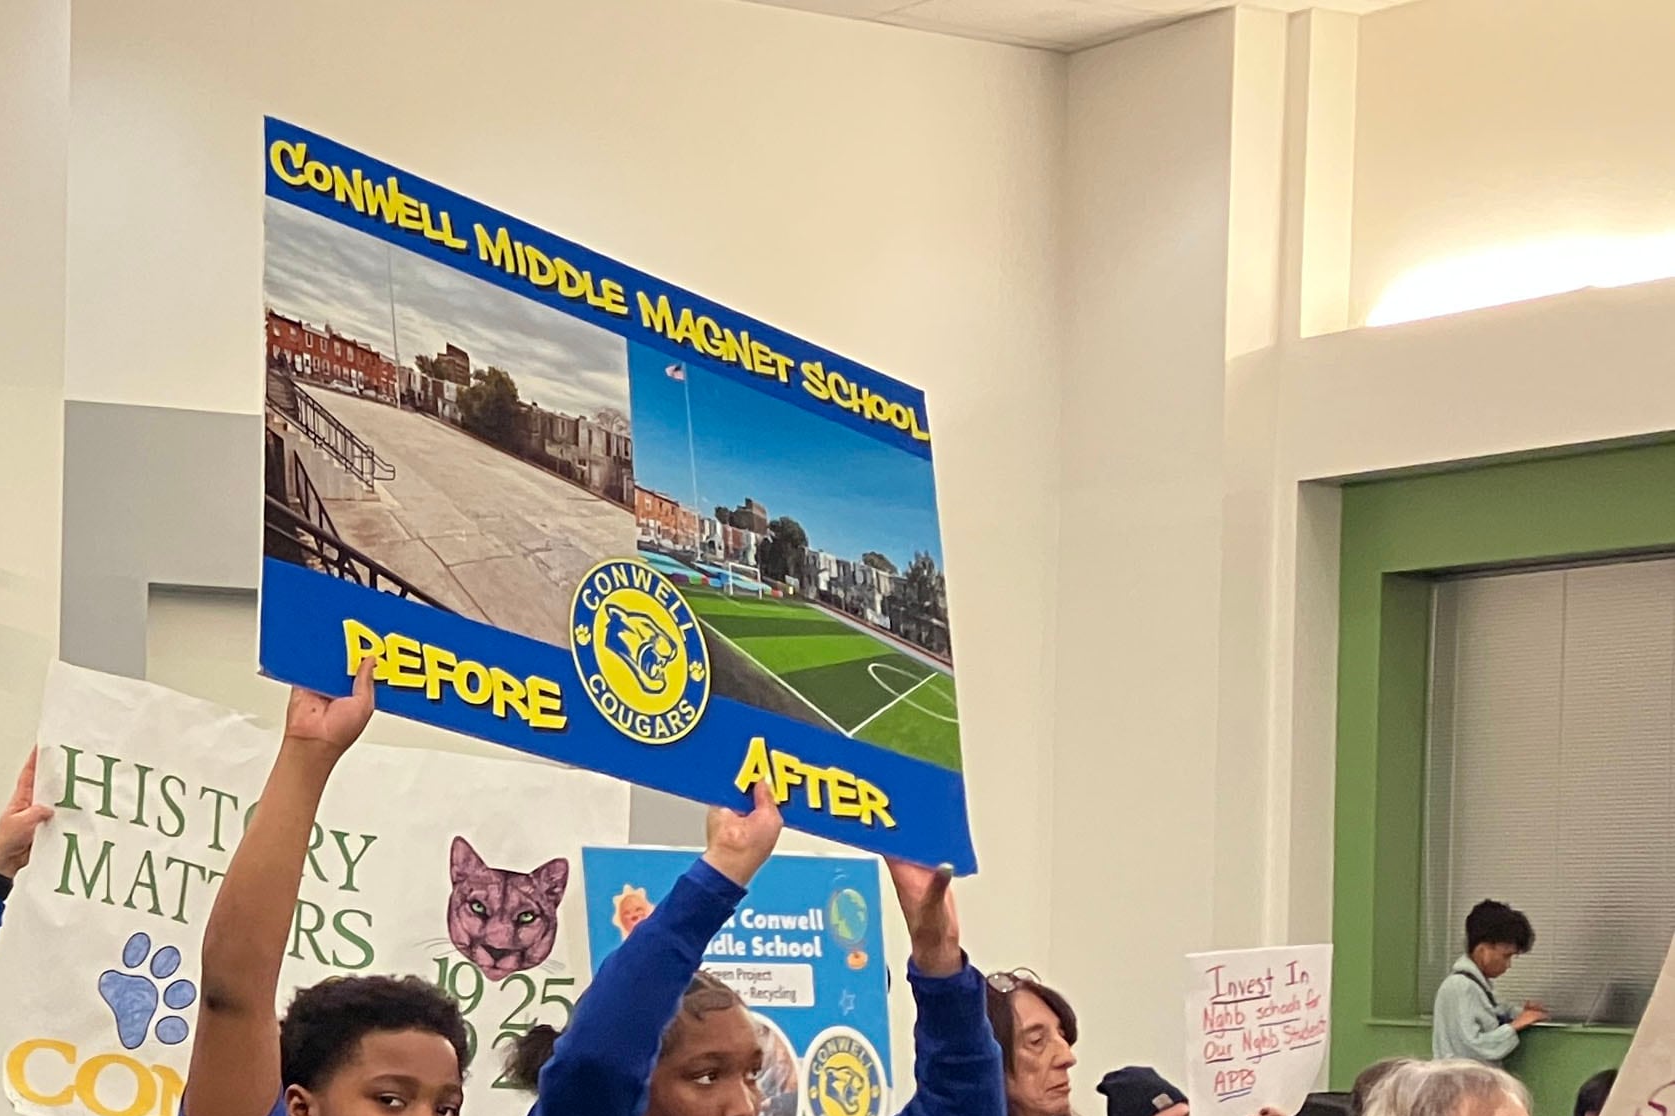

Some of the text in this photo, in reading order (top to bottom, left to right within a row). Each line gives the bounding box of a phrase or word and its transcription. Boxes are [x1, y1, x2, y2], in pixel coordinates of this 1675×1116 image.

[269, 140, 931, 441] CONWELL MIDDLE MAGNET SCHOOL
[582, 564, 695, 642] CONWELL
[343, 618, 568, 730] BEFORE
[588, 673, 697, 739] COUGARS
[734, 736, 897, 829] AFTER
[54, 744, 379, 892] HISTRY
[740, 908, 824, 931] Conwell
[751, 934, 823, 958] School
[432, 956, 576, 1031] 1925
[736, 968, 773, 985] Project
[749, 986, 798, 1004] Recycling
[1206, 960, 1310, 1001] Invest In
